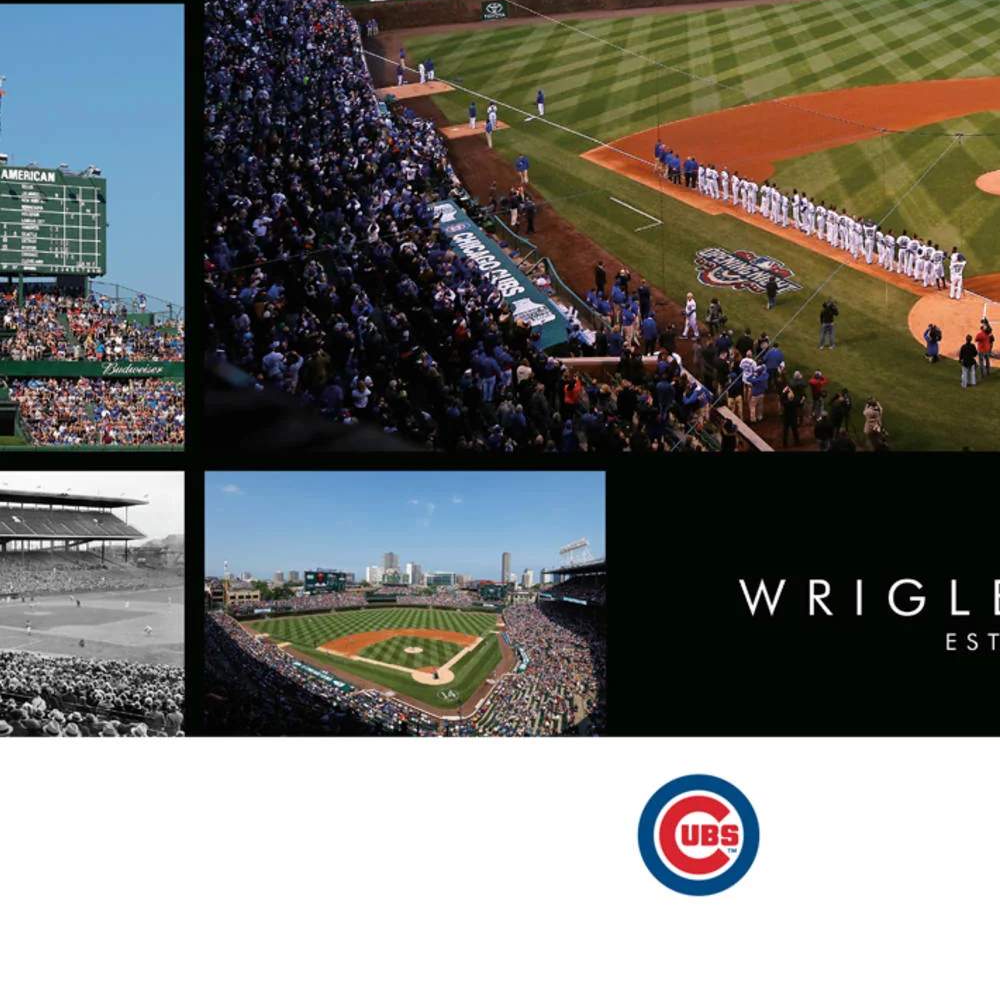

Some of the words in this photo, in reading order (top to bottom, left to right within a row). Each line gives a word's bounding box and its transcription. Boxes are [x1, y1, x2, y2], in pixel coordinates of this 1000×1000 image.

[1, 169, 56, 182] AMERICAN
[452, 232, 501, 271] CHICAGO
[484, 269, 525, 297] CUBS
[102, 362, 164, 375] Budweiser
